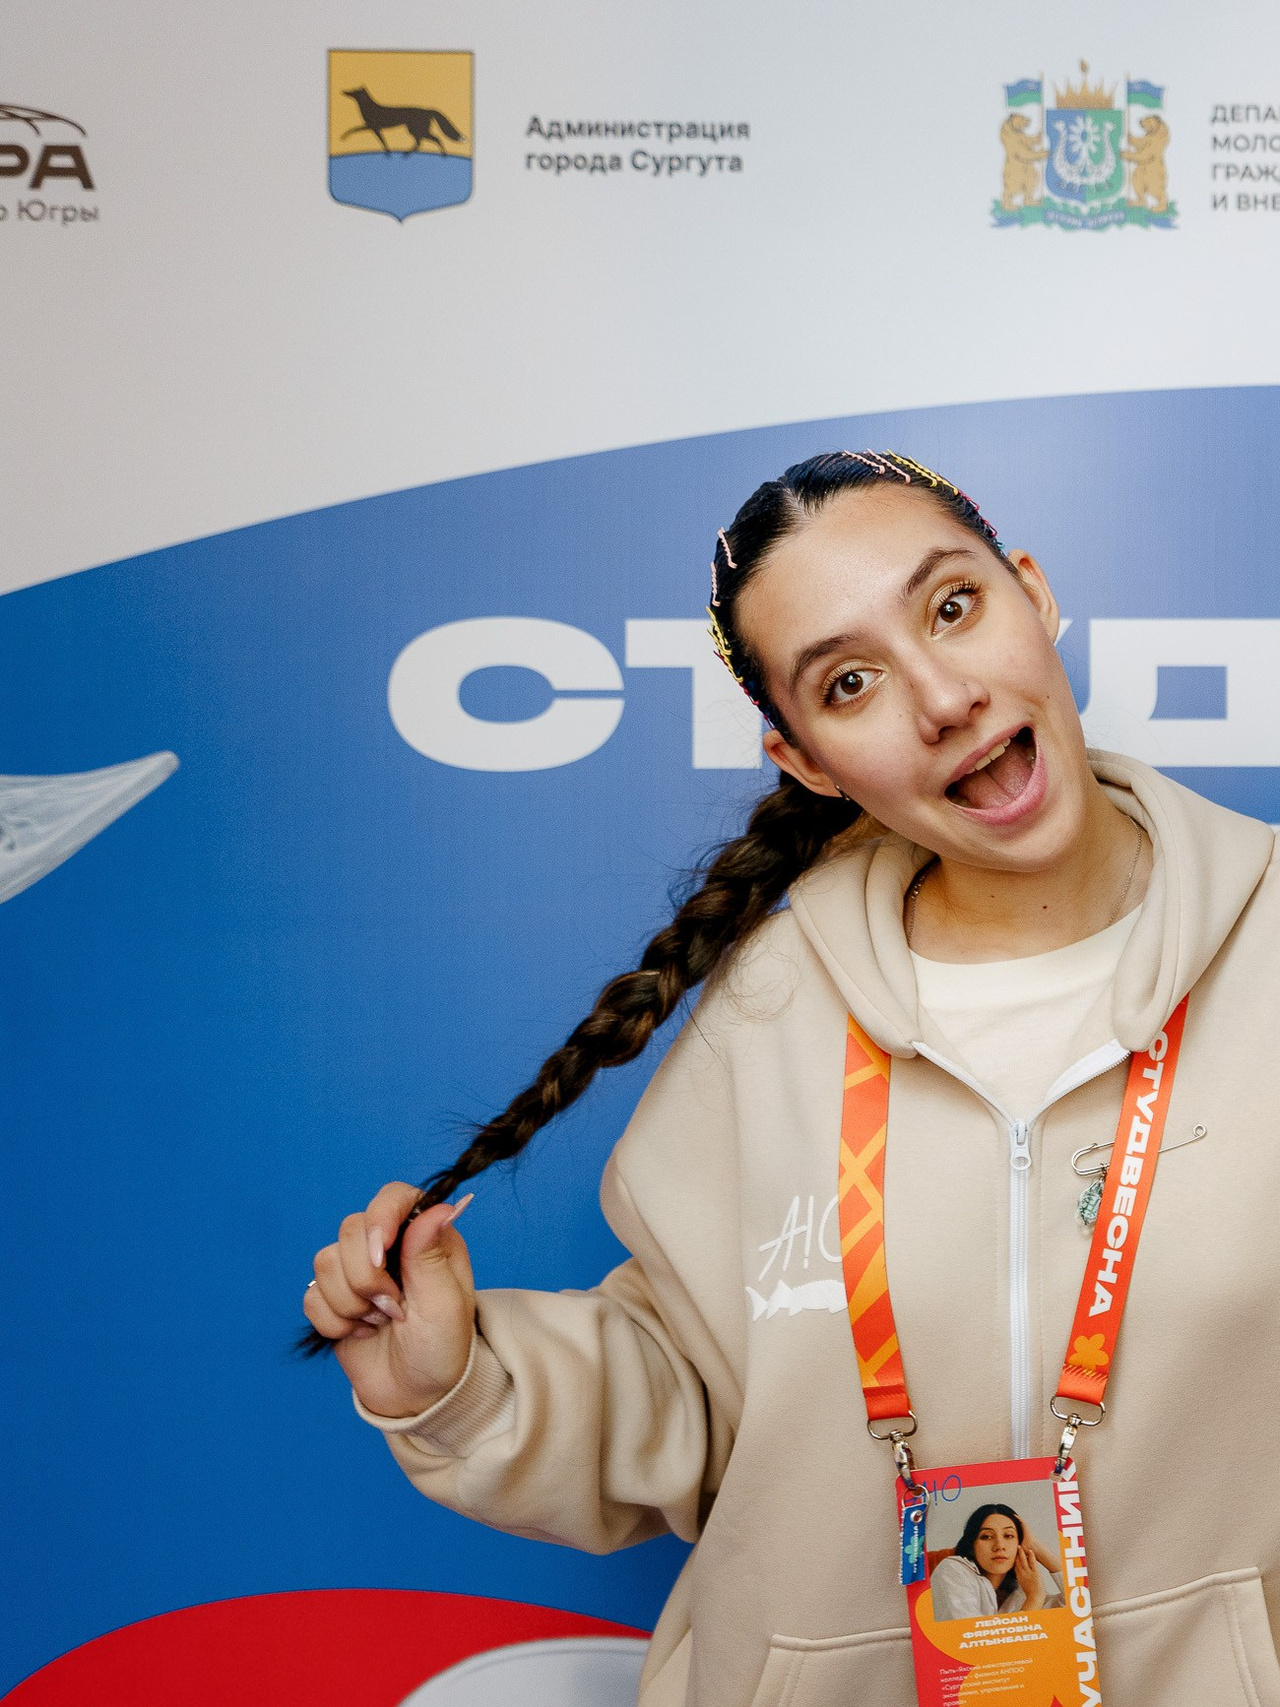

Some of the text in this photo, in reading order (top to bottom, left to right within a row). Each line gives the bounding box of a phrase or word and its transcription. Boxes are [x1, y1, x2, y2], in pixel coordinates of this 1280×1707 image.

[525, 115, 751, 143] Администрация
[525, 149, 743, 177] города Сургута
[1212, 193, 1228, 212] И
[1088, 1029, 1169, 1318] СТУДВЕСНА
[1056, 1461, 1103, 1707] УЧАСТНИК
[974, 1615, 1029, 1628] ЛЕЙСАН
[959, 1632, 1049, 1649] АЛТЫНБАЕВА
